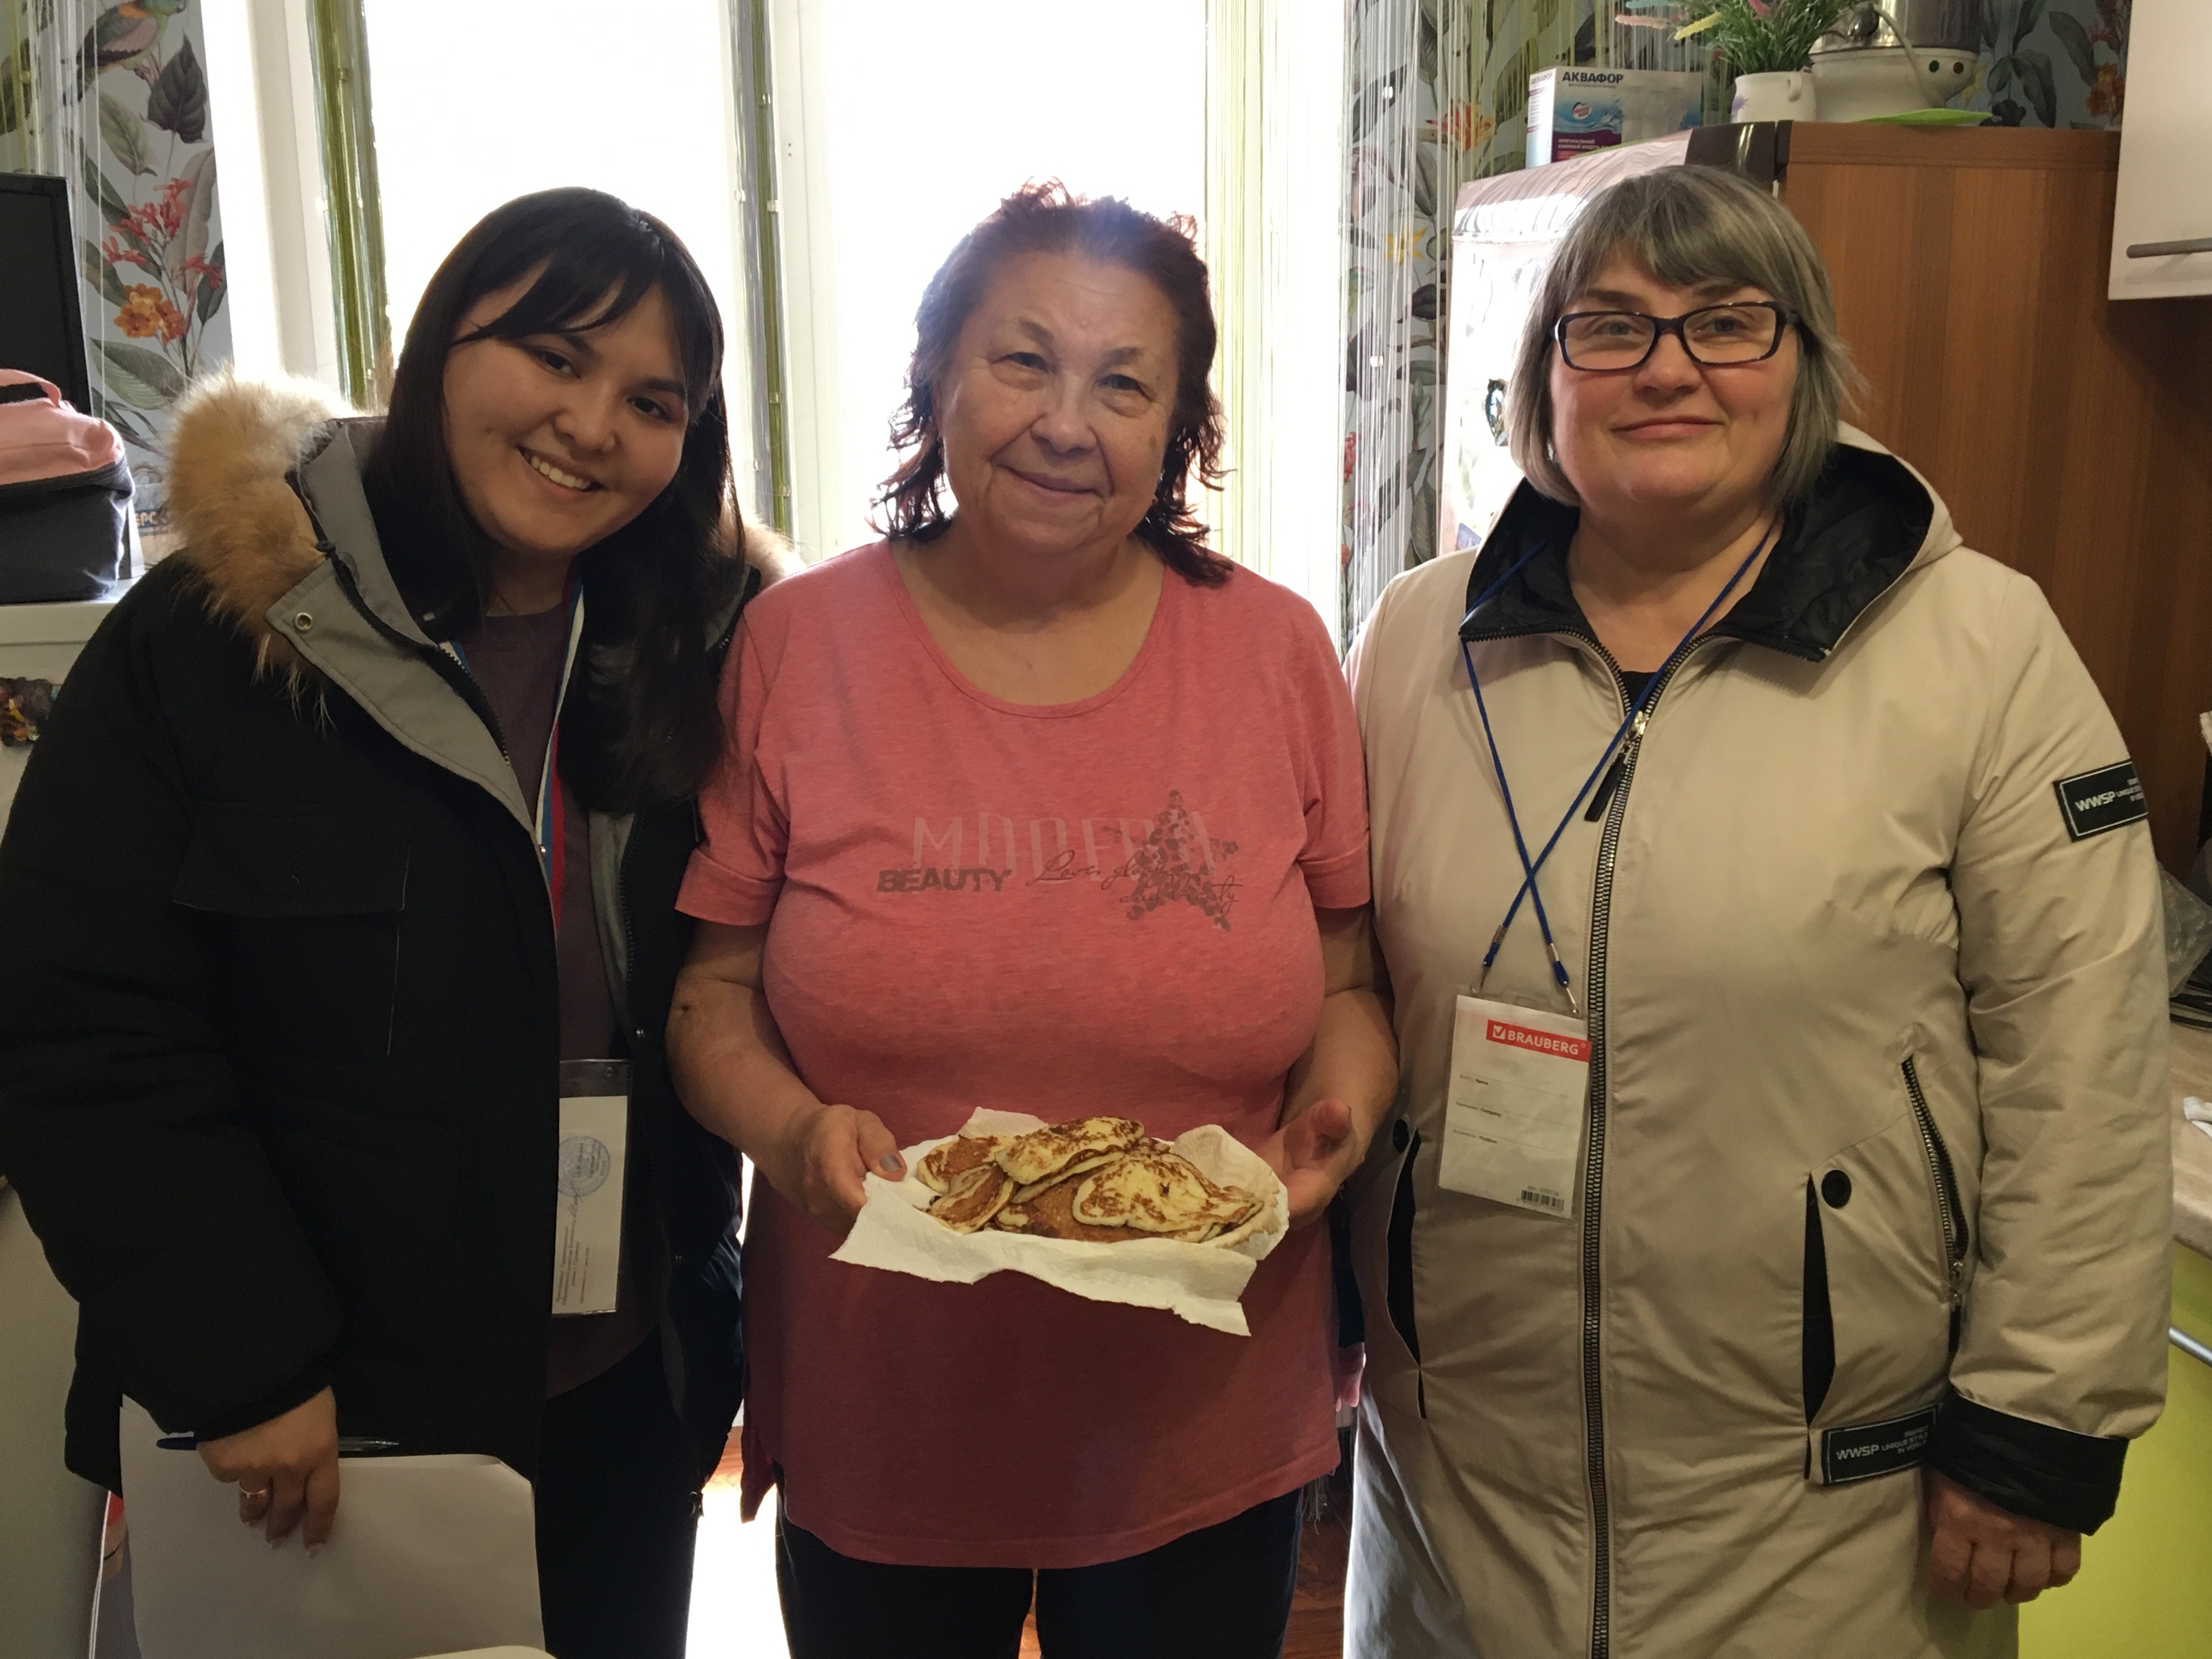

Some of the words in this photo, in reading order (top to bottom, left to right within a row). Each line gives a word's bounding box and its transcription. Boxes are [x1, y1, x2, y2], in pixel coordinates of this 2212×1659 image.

[1562, 71, 1623, 83] АКВАФОР
[2074, 791, 2116, 811] WWSP
[876, 867, 1012, 893] BEAUTY
[1508, 1030, 1579, 1056] BRAUBERG
[1836, 1444, 1880, 1460] WWSP
